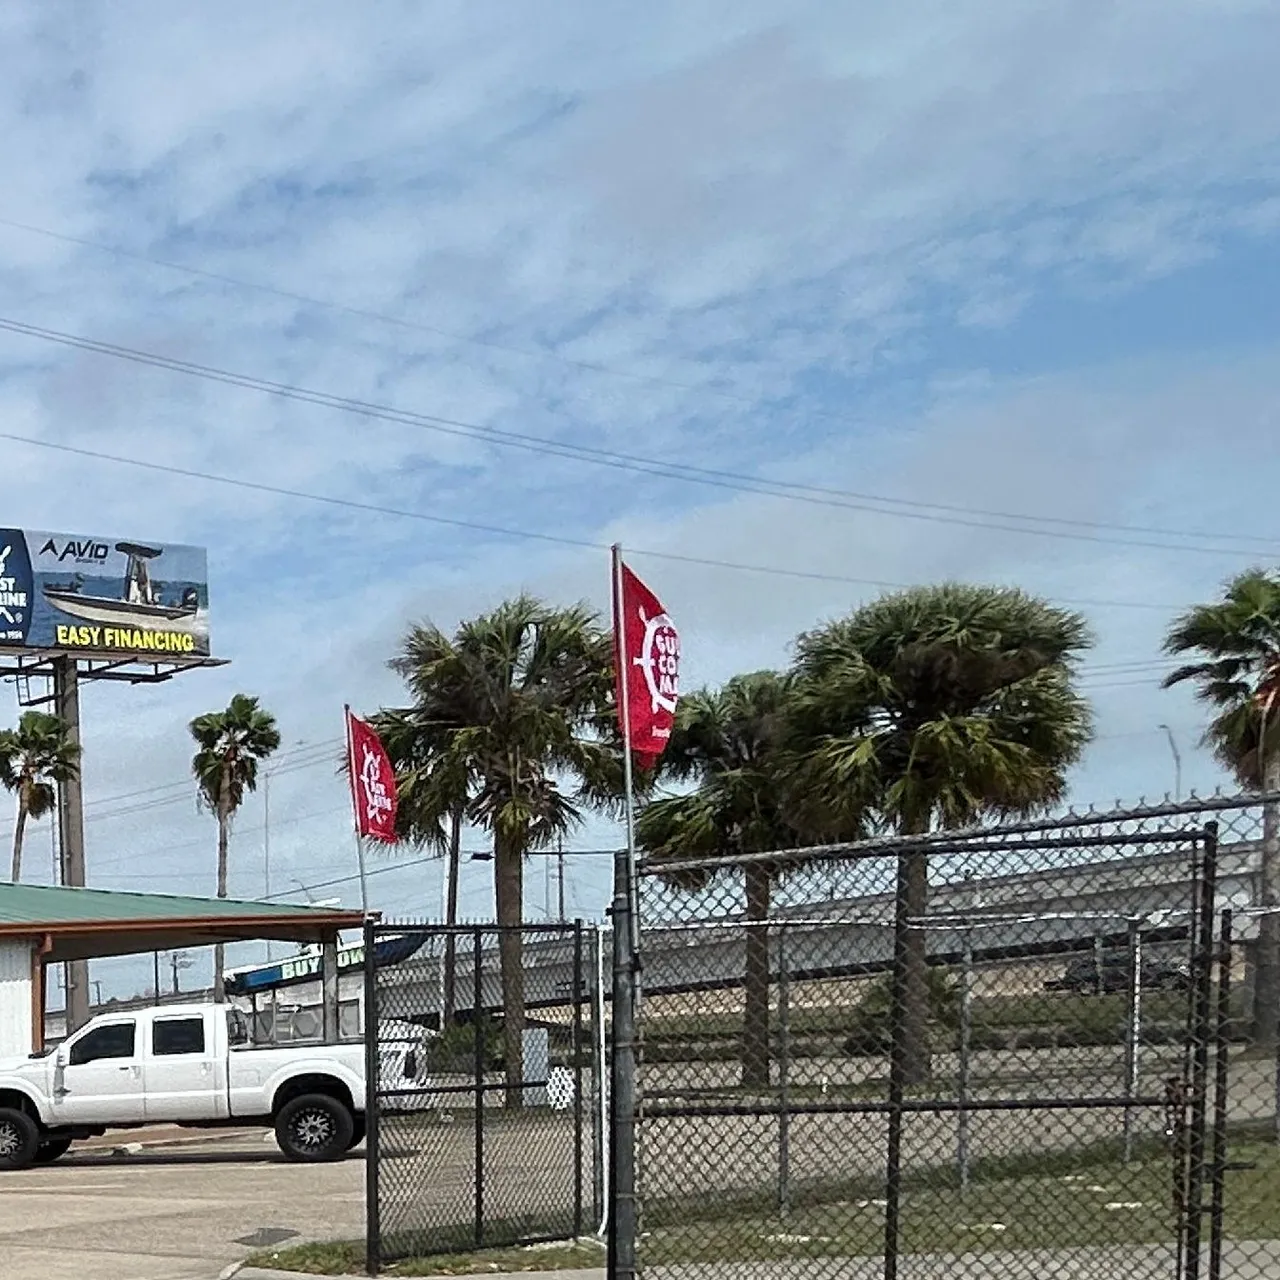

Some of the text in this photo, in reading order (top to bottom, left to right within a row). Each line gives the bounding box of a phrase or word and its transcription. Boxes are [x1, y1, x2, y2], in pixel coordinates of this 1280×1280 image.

[58, 540, 108, 561] AVID
[57, 625, 193, 651] EASY FINANCING
[281, 947, 365, 979] BUY OW
